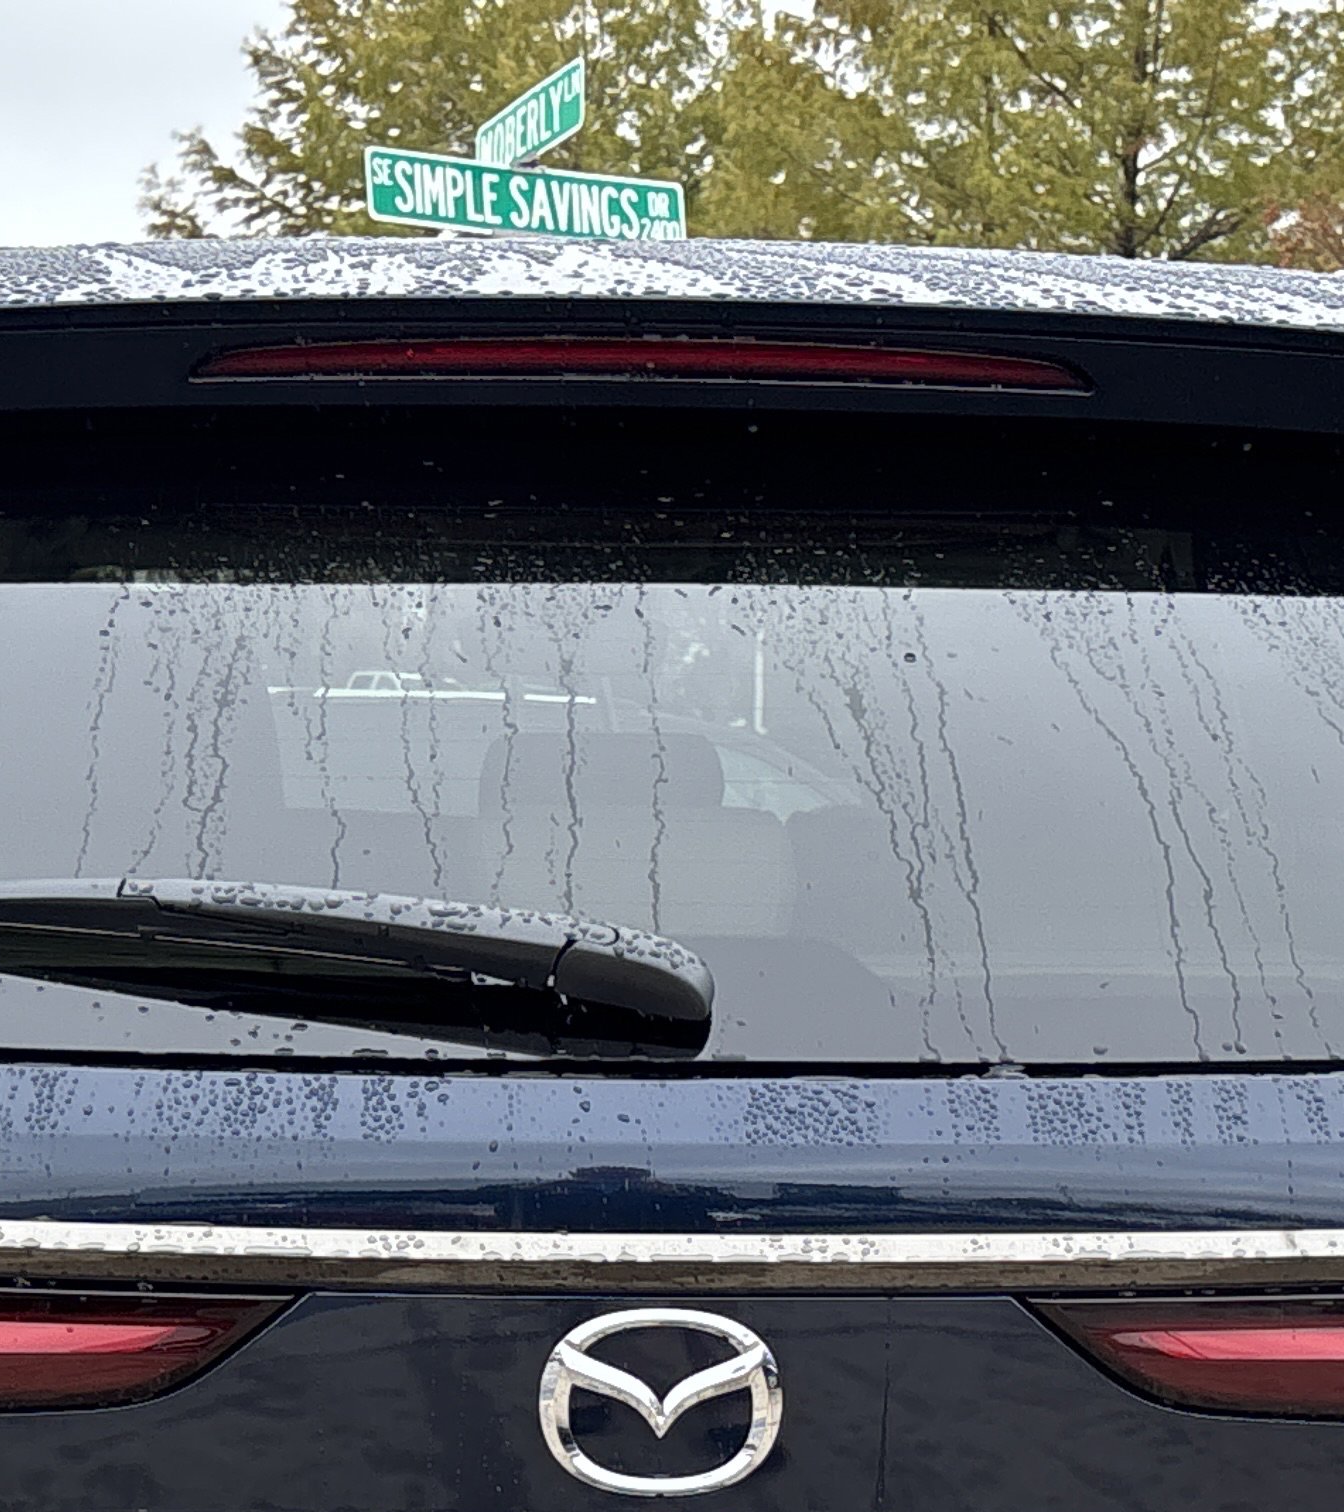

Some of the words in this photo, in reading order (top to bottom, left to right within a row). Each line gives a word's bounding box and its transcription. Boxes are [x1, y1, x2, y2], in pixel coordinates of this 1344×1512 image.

[480, 80, 563, 164] MOBERLY
[564, 69, 580, 102] LN
[372, 157, 394, 185] SE
[394, 160, 503, 226] SIMPLE
[509, 174, 639, 240] SAVINGS
[647, 191, 670, 219] DR
